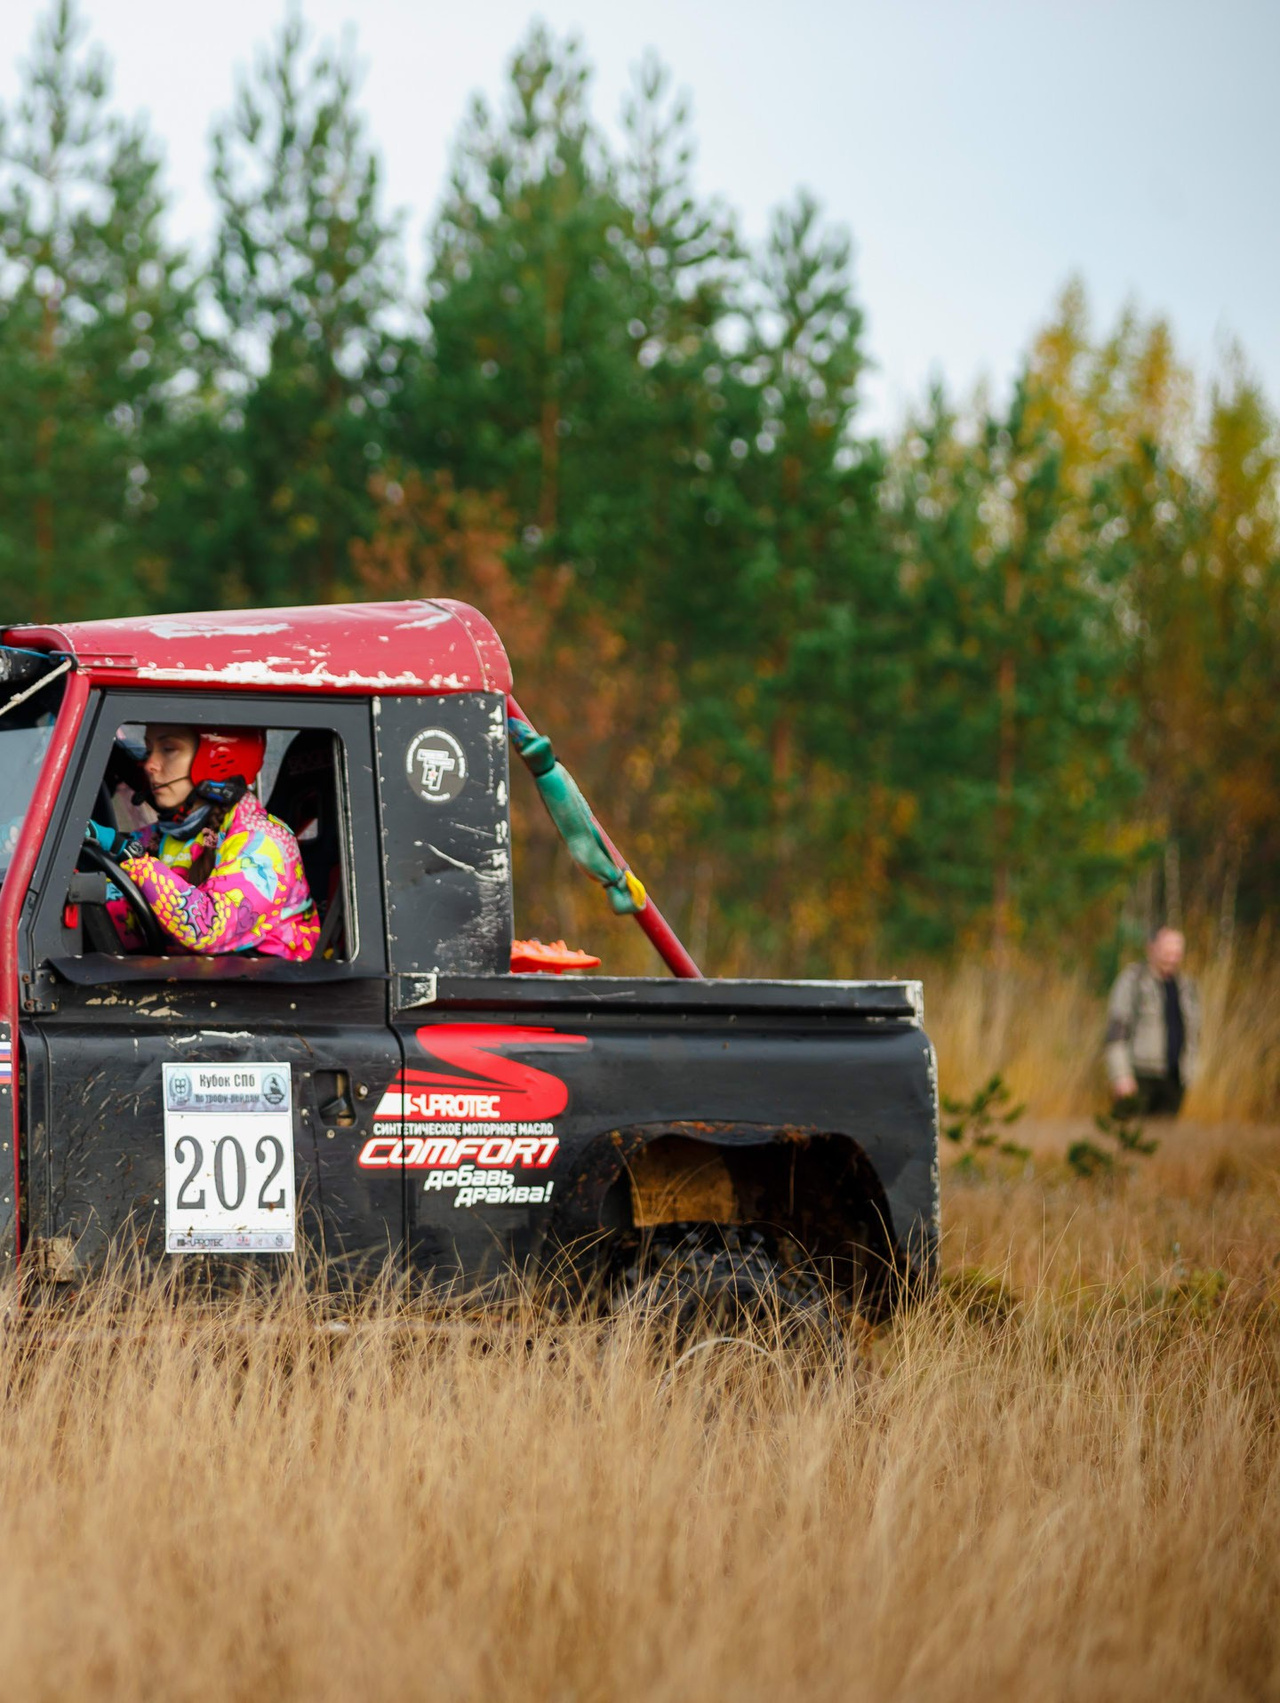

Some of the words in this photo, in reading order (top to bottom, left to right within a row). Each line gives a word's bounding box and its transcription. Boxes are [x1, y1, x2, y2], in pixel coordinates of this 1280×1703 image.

[199, 1073, 231, 1088] Кубок
[234, 1073, 255, 1087] СПб
[373, 1122, 462, 1136] СИНТЕТИЧЕСКОЕ
[463, 1122, 518, 1136] МОТОРНОЕ
[518, 1122, 554, 1136] МАСЛО
[358, 1137, 560, 1166] COMFORT
[174, 1135, 286, 1210] 202
[424, 1165, 515, 1190] добавь
[454, 1181, 554, 1207] драйва!
